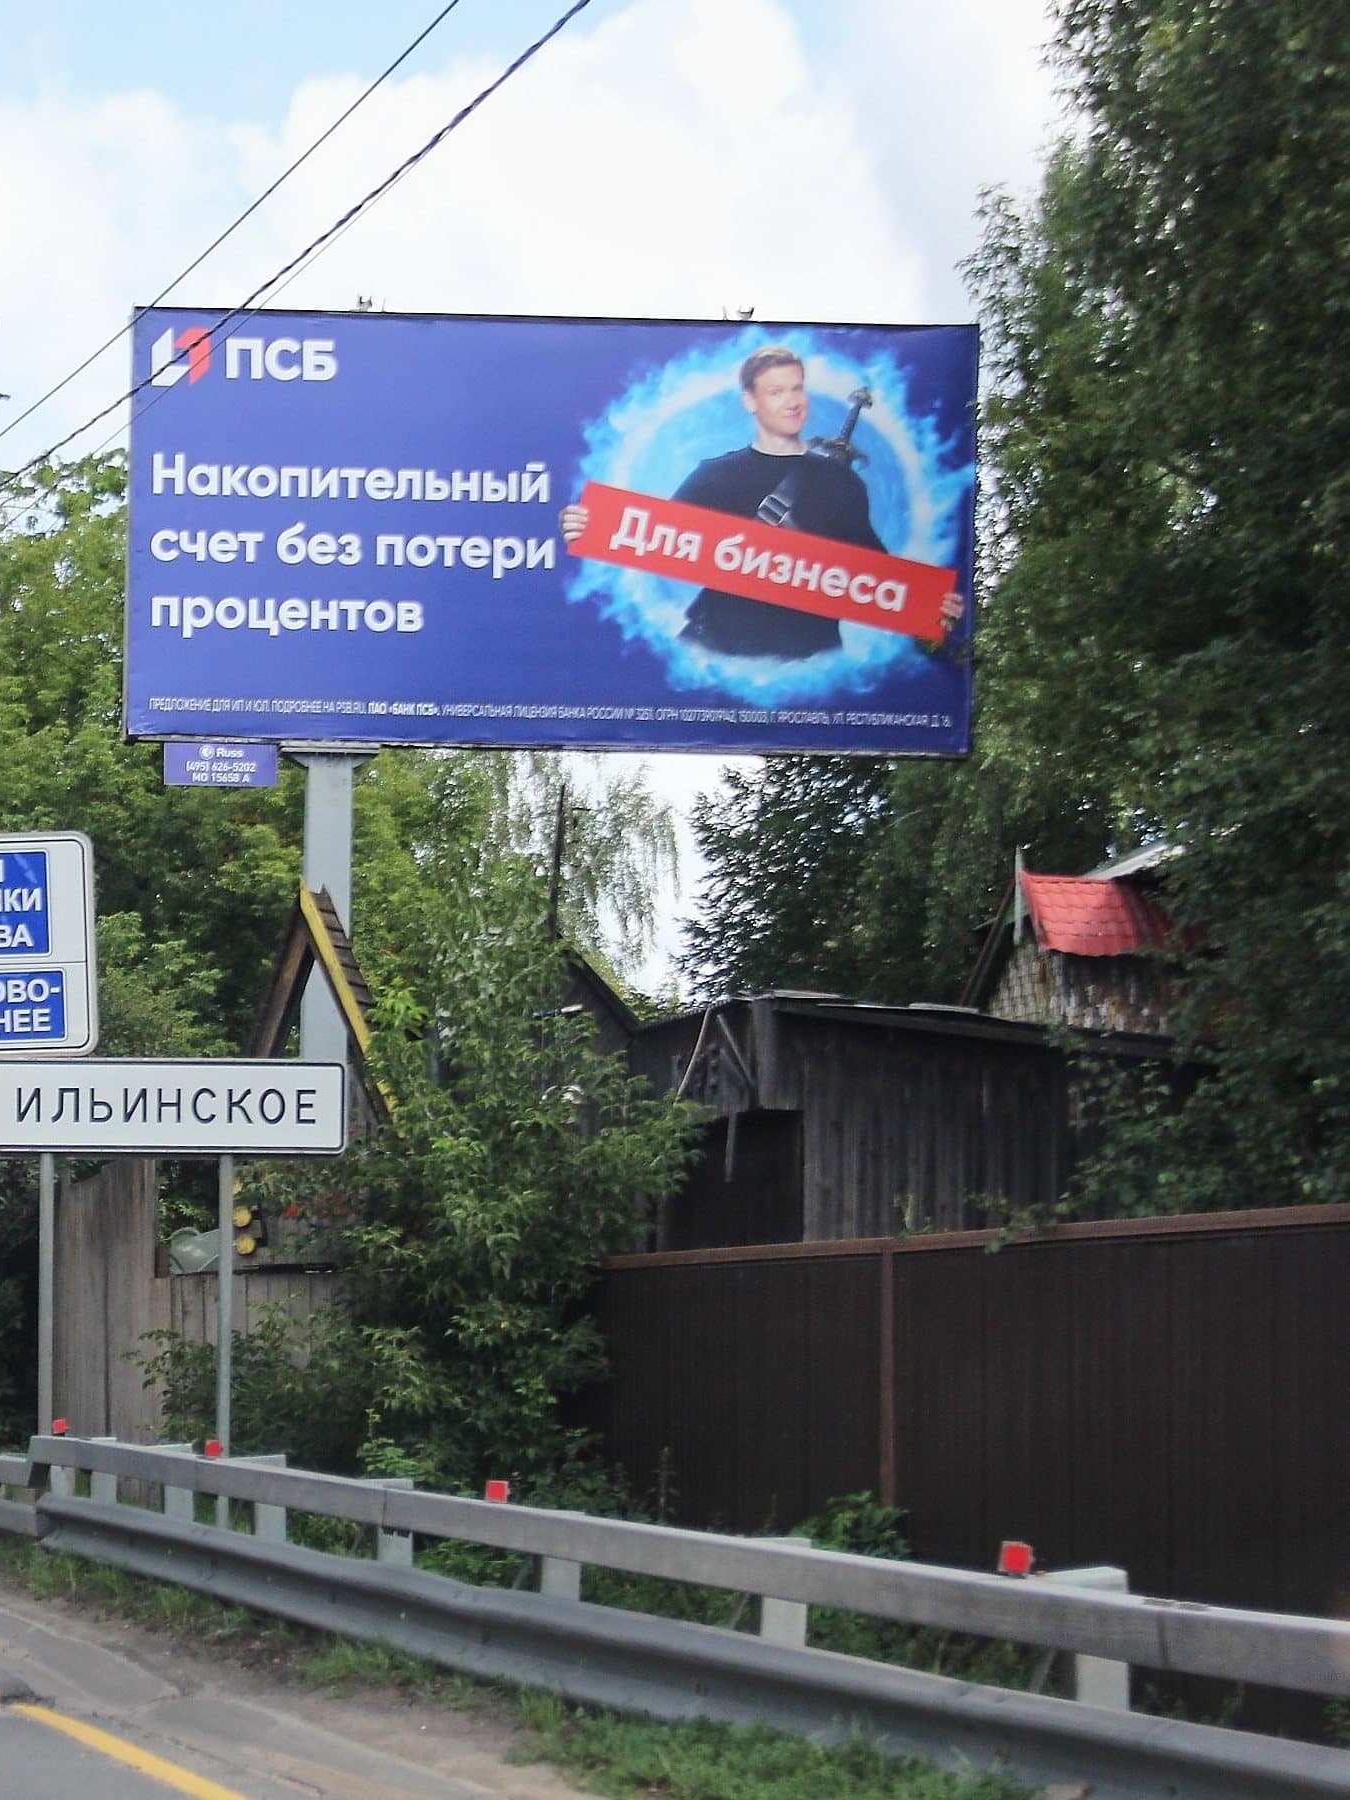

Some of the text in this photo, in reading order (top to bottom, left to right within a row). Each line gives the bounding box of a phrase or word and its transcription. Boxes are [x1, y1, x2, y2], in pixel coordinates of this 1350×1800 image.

[225, 337, 338, 381] ПСБ
[151, 453, 551, 504] Накопительный
[150, 522, 556, 579] счет без потери
[608, 508, 909, 612] Для бизнеса
[150, 596, 425, 638] процентов
[149, 698, 211, 711] ПРЕДЛОЖЕНИЕ
[212, 699, 230, 712] ДЛЯ
[232, 699, 244, 712] ИП
[272, 700, 322, 713] ПОДРОБНЕЕ
[323, 701, 335, 713] НА
[368, 702, 387, 714] ПАО
[186, 761, 257, 773] (495) 626-5202
[216, 748, 244, 758] Russ
[16, 1086, 318, 1124] ИЛЬИНСКОЕ
